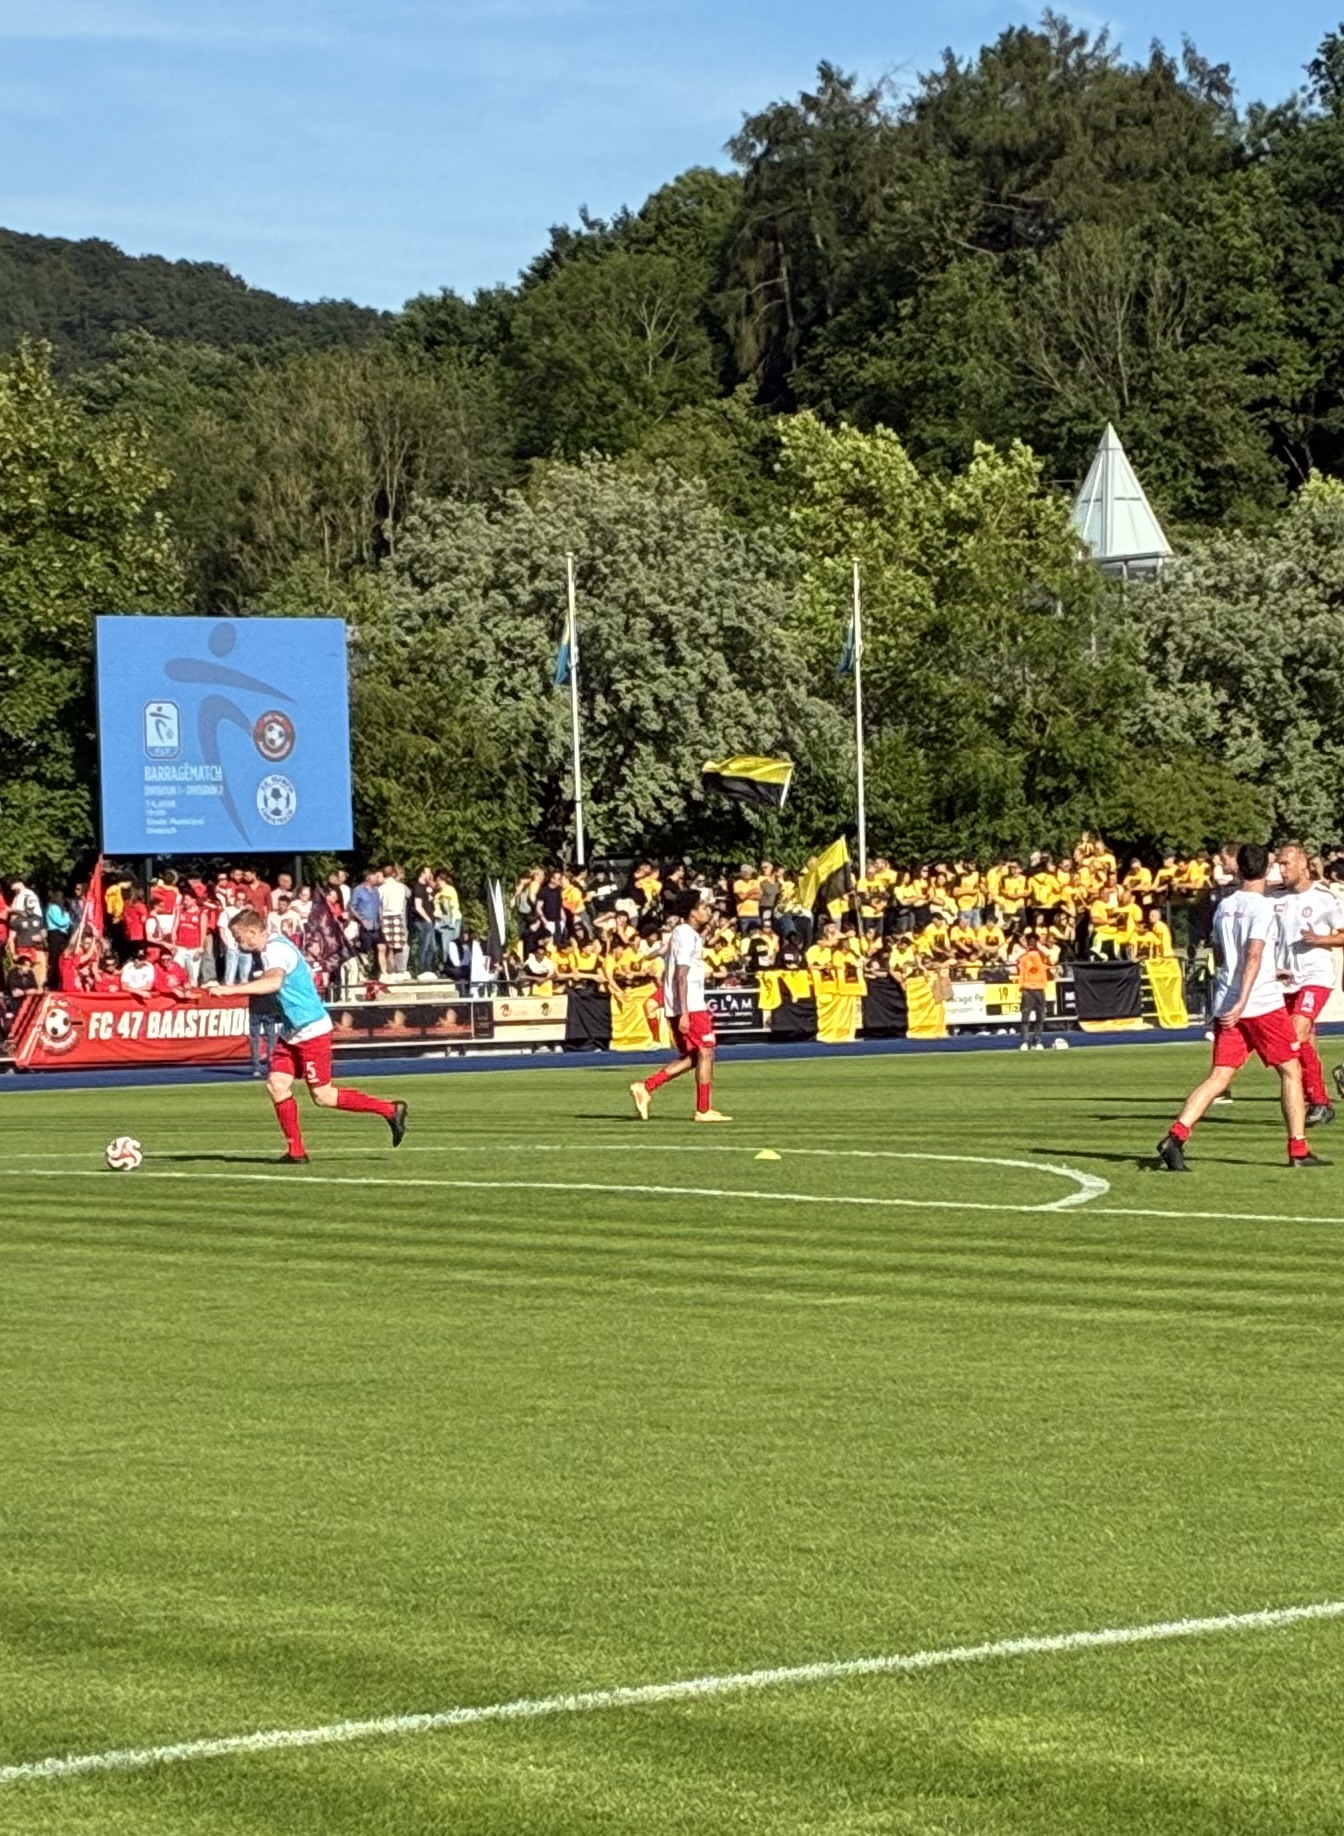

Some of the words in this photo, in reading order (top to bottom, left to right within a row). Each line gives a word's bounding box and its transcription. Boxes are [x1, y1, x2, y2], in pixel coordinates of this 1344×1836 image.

[706, 997, 753, 1012] GLAM
[88, 1012, 113, 1040] FC
[117, 1011, 144, 1040] 47
[306, 1061, 317, 1079] 5
